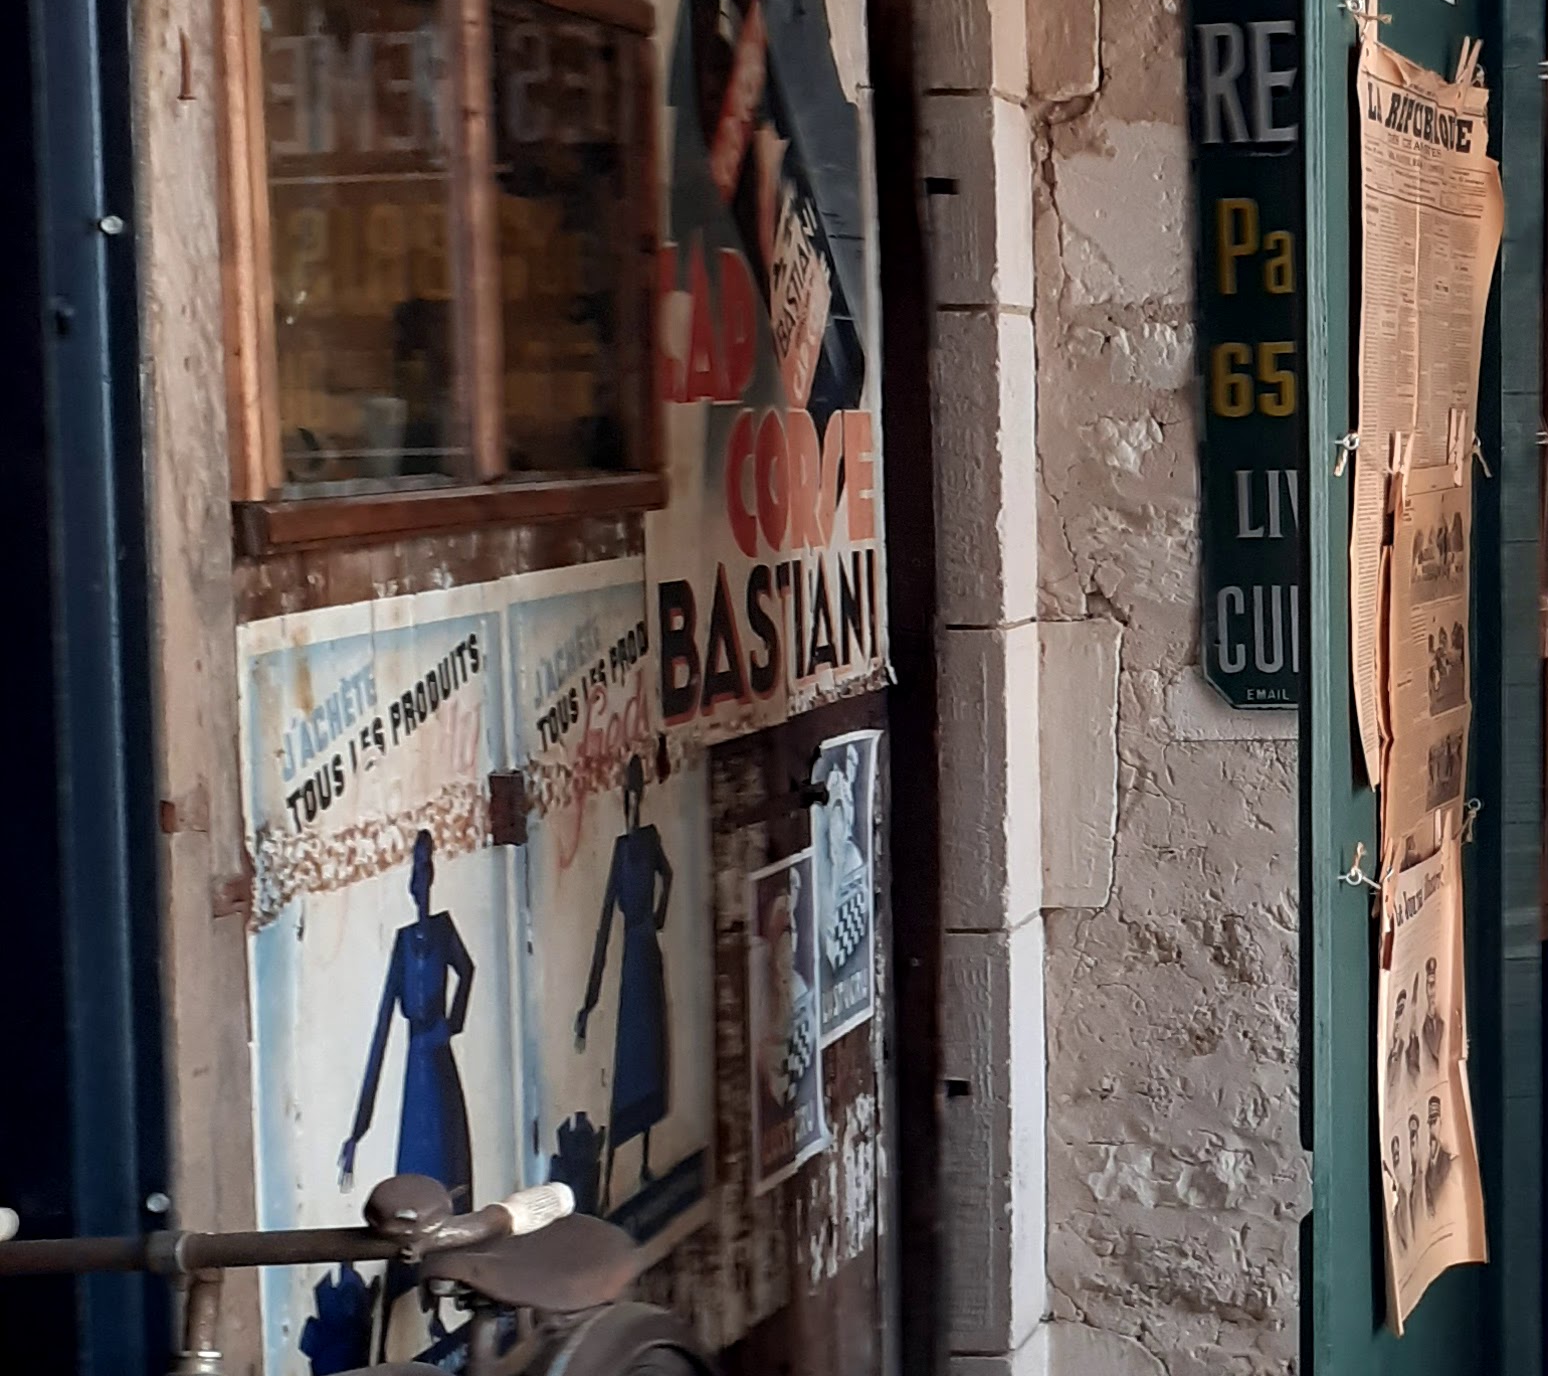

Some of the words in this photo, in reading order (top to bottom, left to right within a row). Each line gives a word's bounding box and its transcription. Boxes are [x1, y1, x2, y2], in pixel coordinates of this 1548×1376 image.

[657, 547, 880, 725] BASTIANI
[1246, 686, 1289, 701] EMAIL
[285, 753, 345, 829] TOUS
[348, 716, 388, 771] LES
[387, 631, 482, 748] PRODUITS
[536, 686, 580, 753] TOUS
